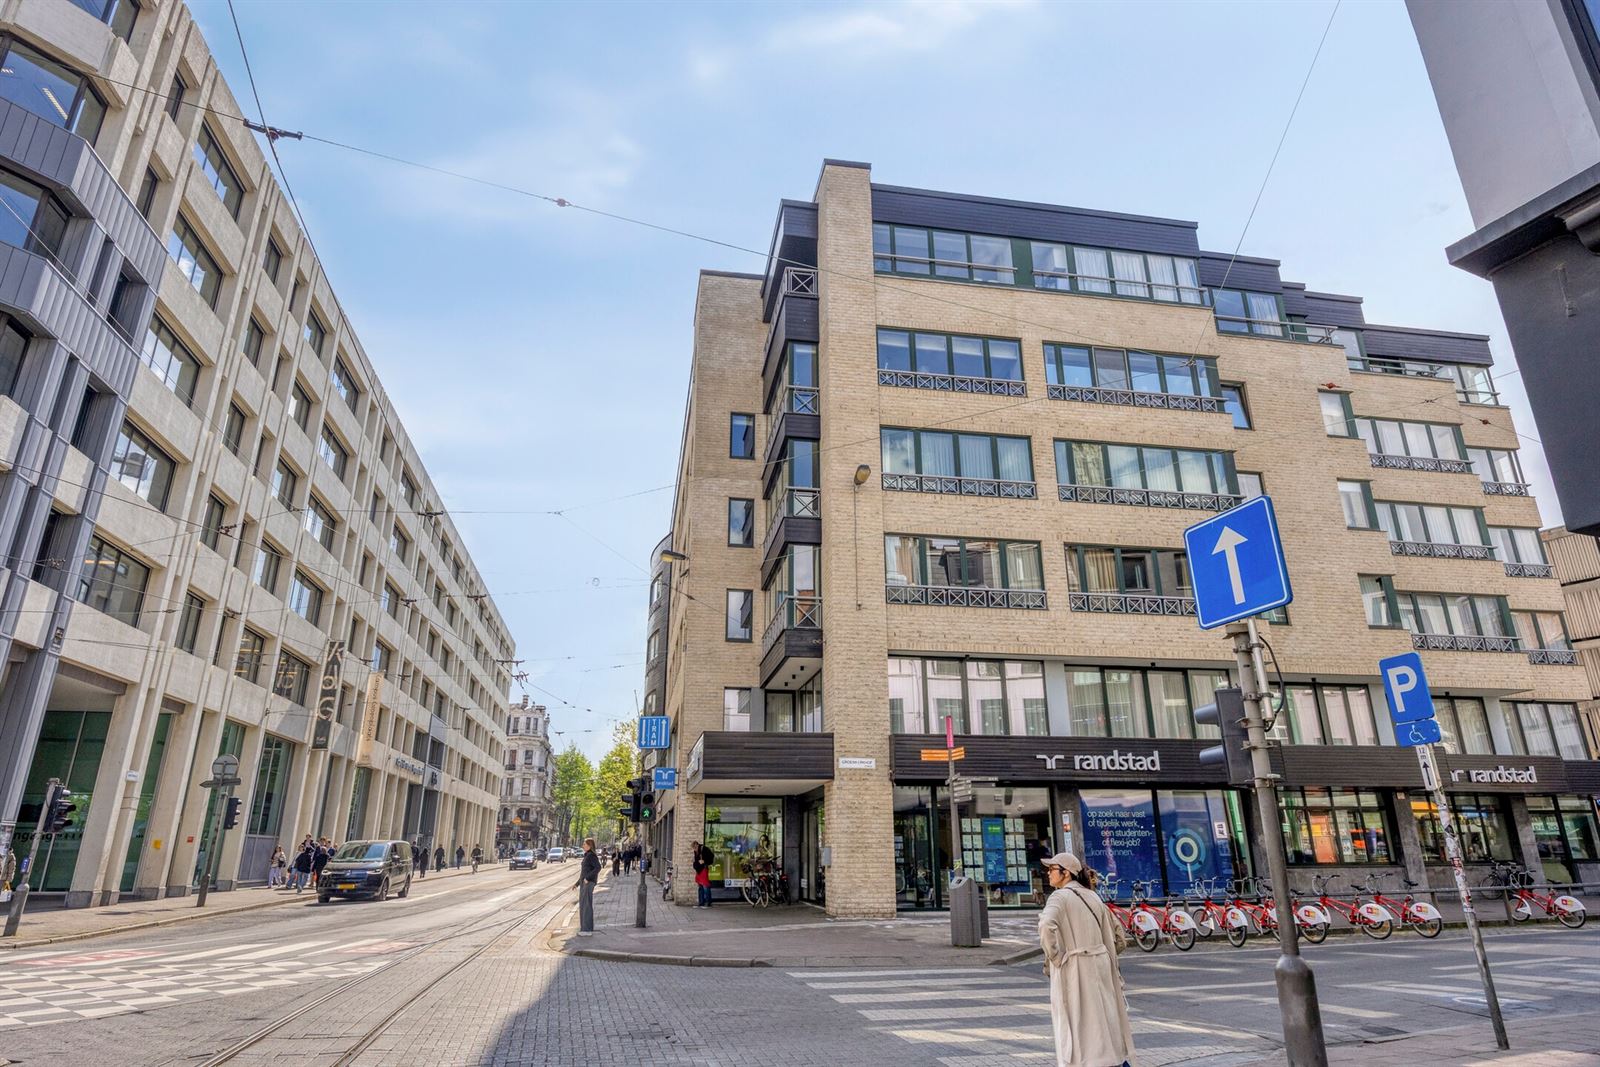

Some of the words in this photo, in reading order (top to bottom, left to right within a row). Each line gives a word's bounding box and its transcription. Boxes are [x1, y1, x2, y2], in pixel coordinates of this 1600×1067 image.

[1387, 665, 1417, 712] P
[1074, 749, 1160, 770] randstad
[1470, 765, 1538, 783] randstad
[1131, 810, 1146, 818] vast
[1088, 819, 1096, 827] of
[1096, 819, 1120, 828] tijdelijk
[1121, 819, 1140, 828] werk,
[1115, 828, 1152, 837] studenten-
[1102, 838, 1110, 846] of
[1110, 838, 1141, 848] flexi-job?
